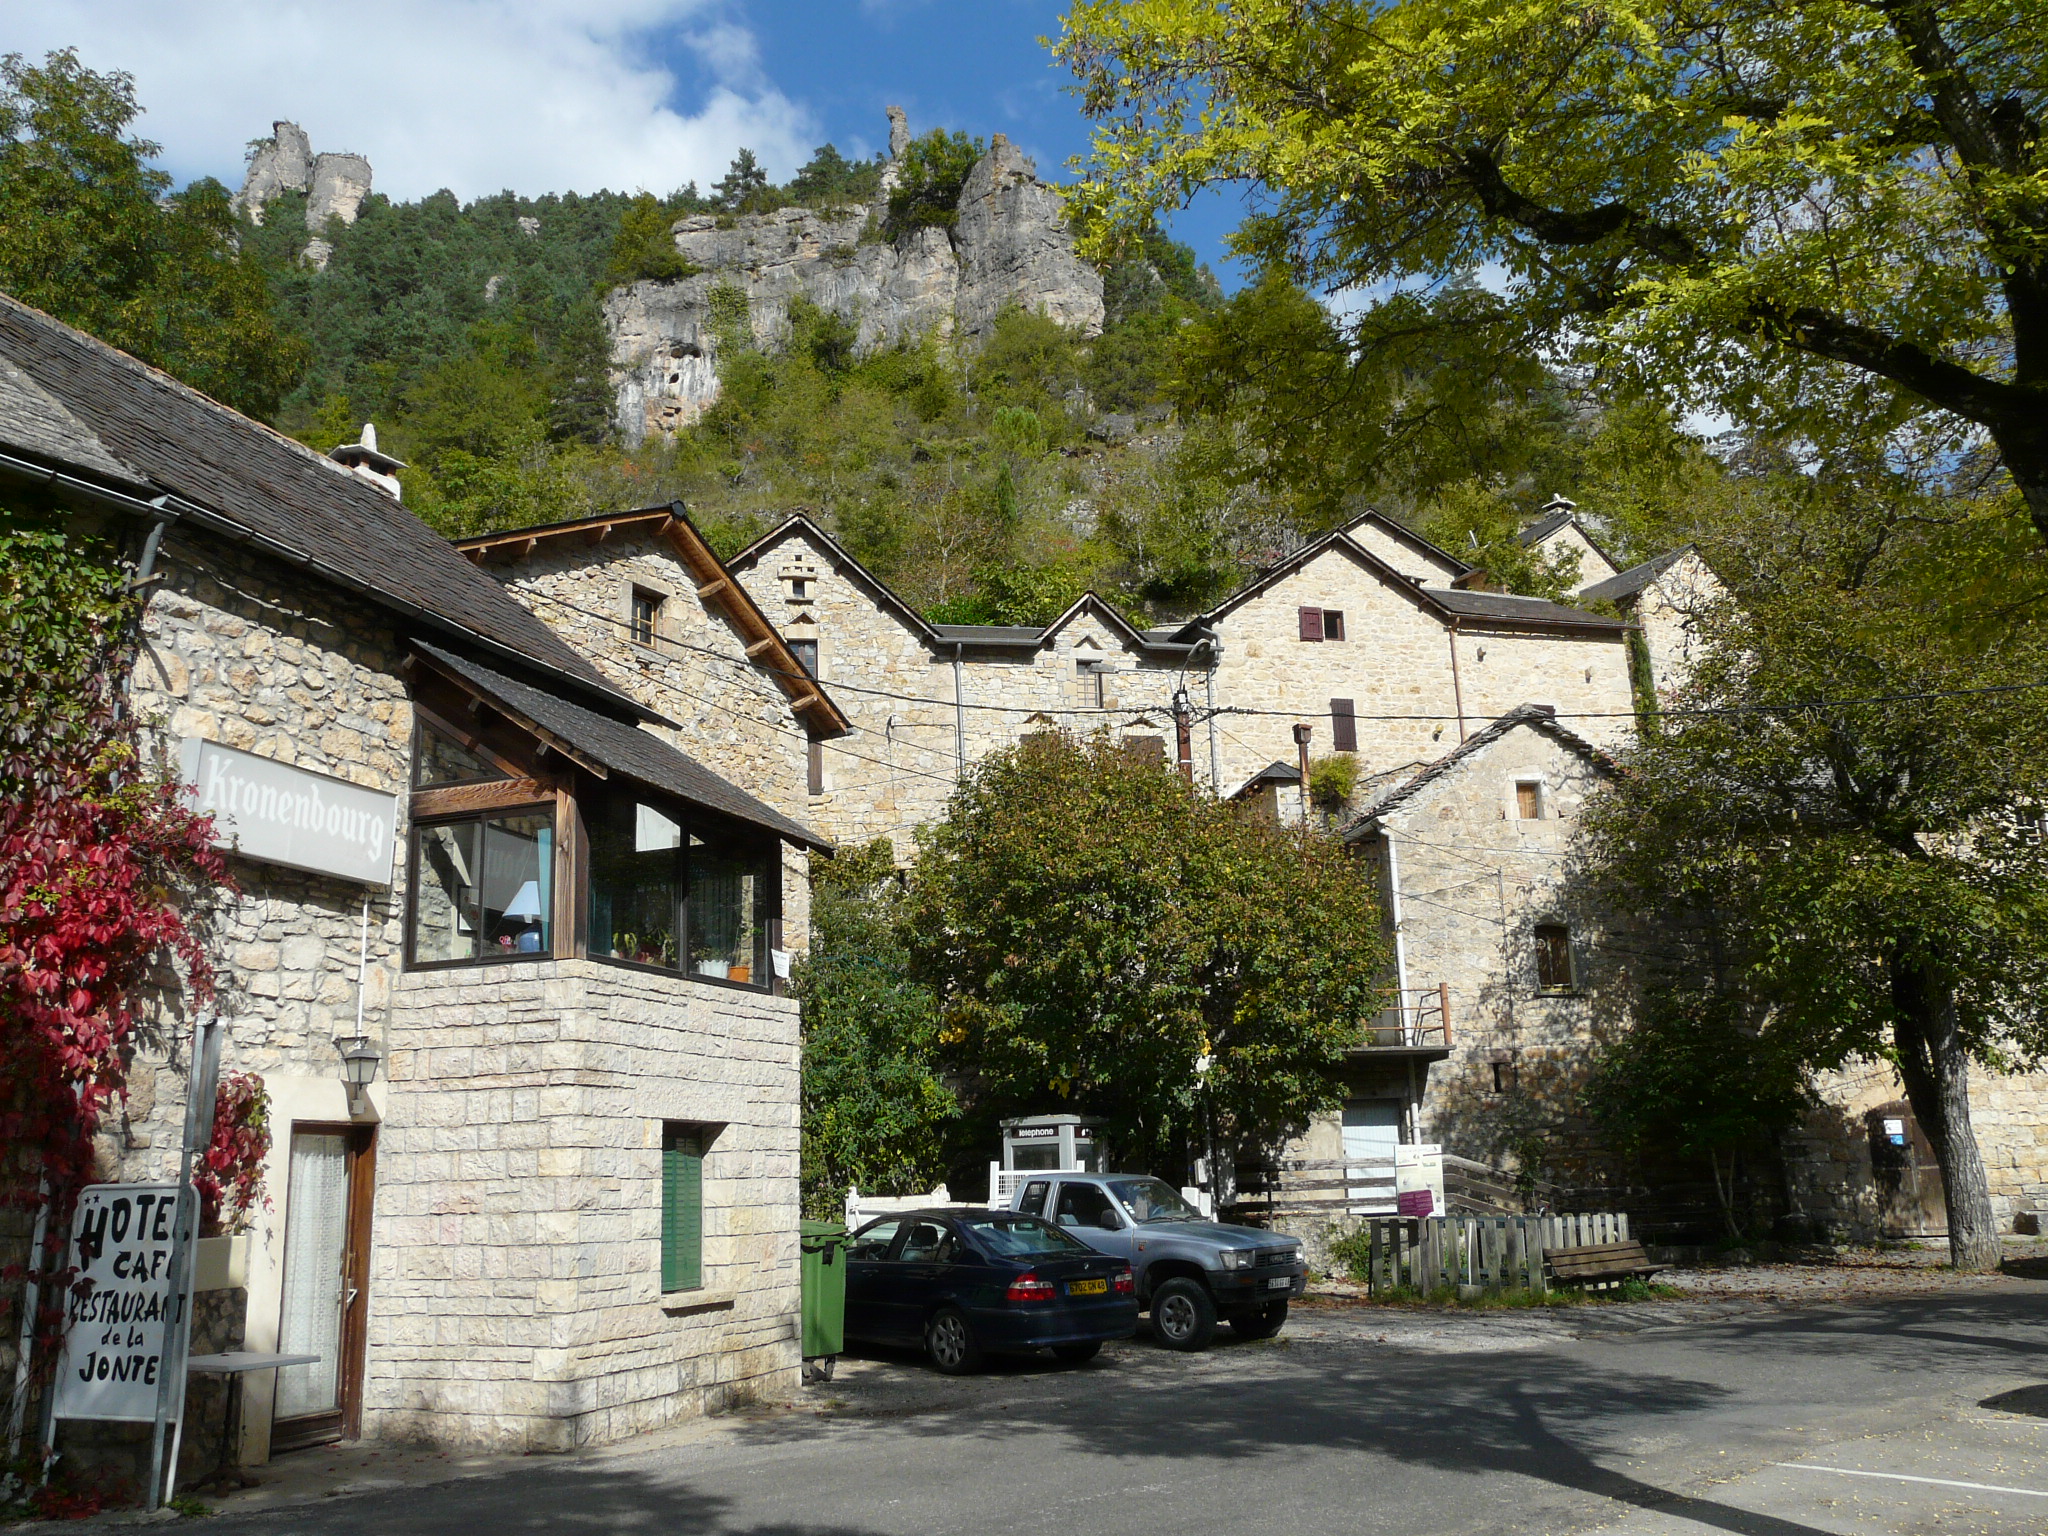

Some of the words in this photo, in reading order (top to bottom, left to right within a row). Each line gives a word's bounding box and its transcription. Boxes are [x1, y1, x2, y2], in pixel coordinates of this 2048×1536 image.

[202, 753, 385, 863] Kronenbourg
[113, 1250, 174, 1283] CAF
[101, 1325, 121, 1346] de
[127, 1325, 144, 1349] la
[79, 1350, 159, 1386] JONTE
